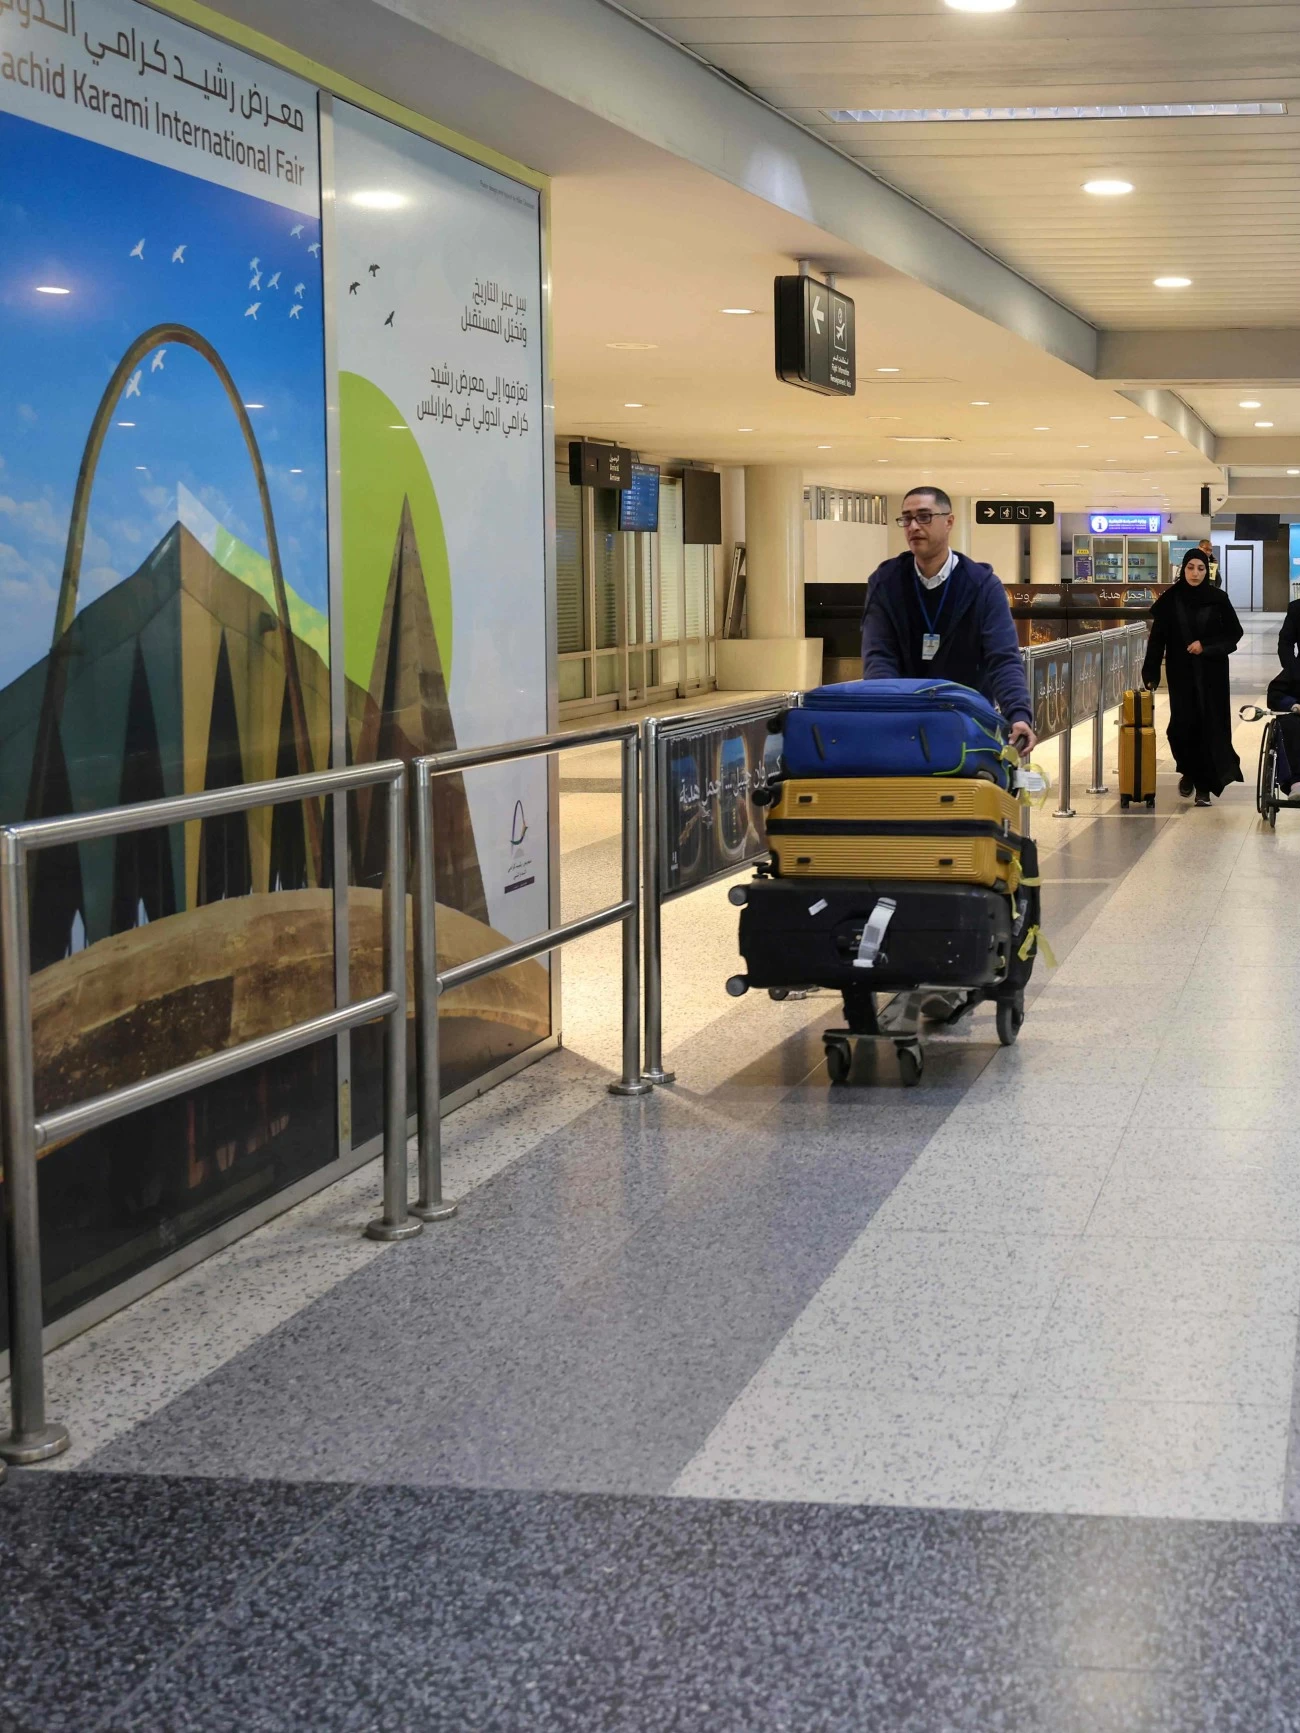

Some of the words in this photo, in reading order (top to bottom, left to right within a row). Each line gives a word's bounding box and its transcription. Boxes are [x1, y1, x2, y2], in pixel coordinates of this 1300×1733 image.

[84, 27, 167, 76] كرامي
[174, 55, 235, 113] رشيد
[240, 83, 304, 132] معرض
[73, 69, 149, 130] Karami
[155, 101, 271, 175] International
[275, 148, 305, 186] Fair
[461, 305, 502, 335] المستقبل
[430, 362, 454, 393] رشيد
[455, 369, 485, 396] معرض
[416, 394, 453, 425] طرابلس
[455, 402, 471, 432] في
[473, 403, 501, 434] الدولي
[502, 410, 529, 439] كرامي
